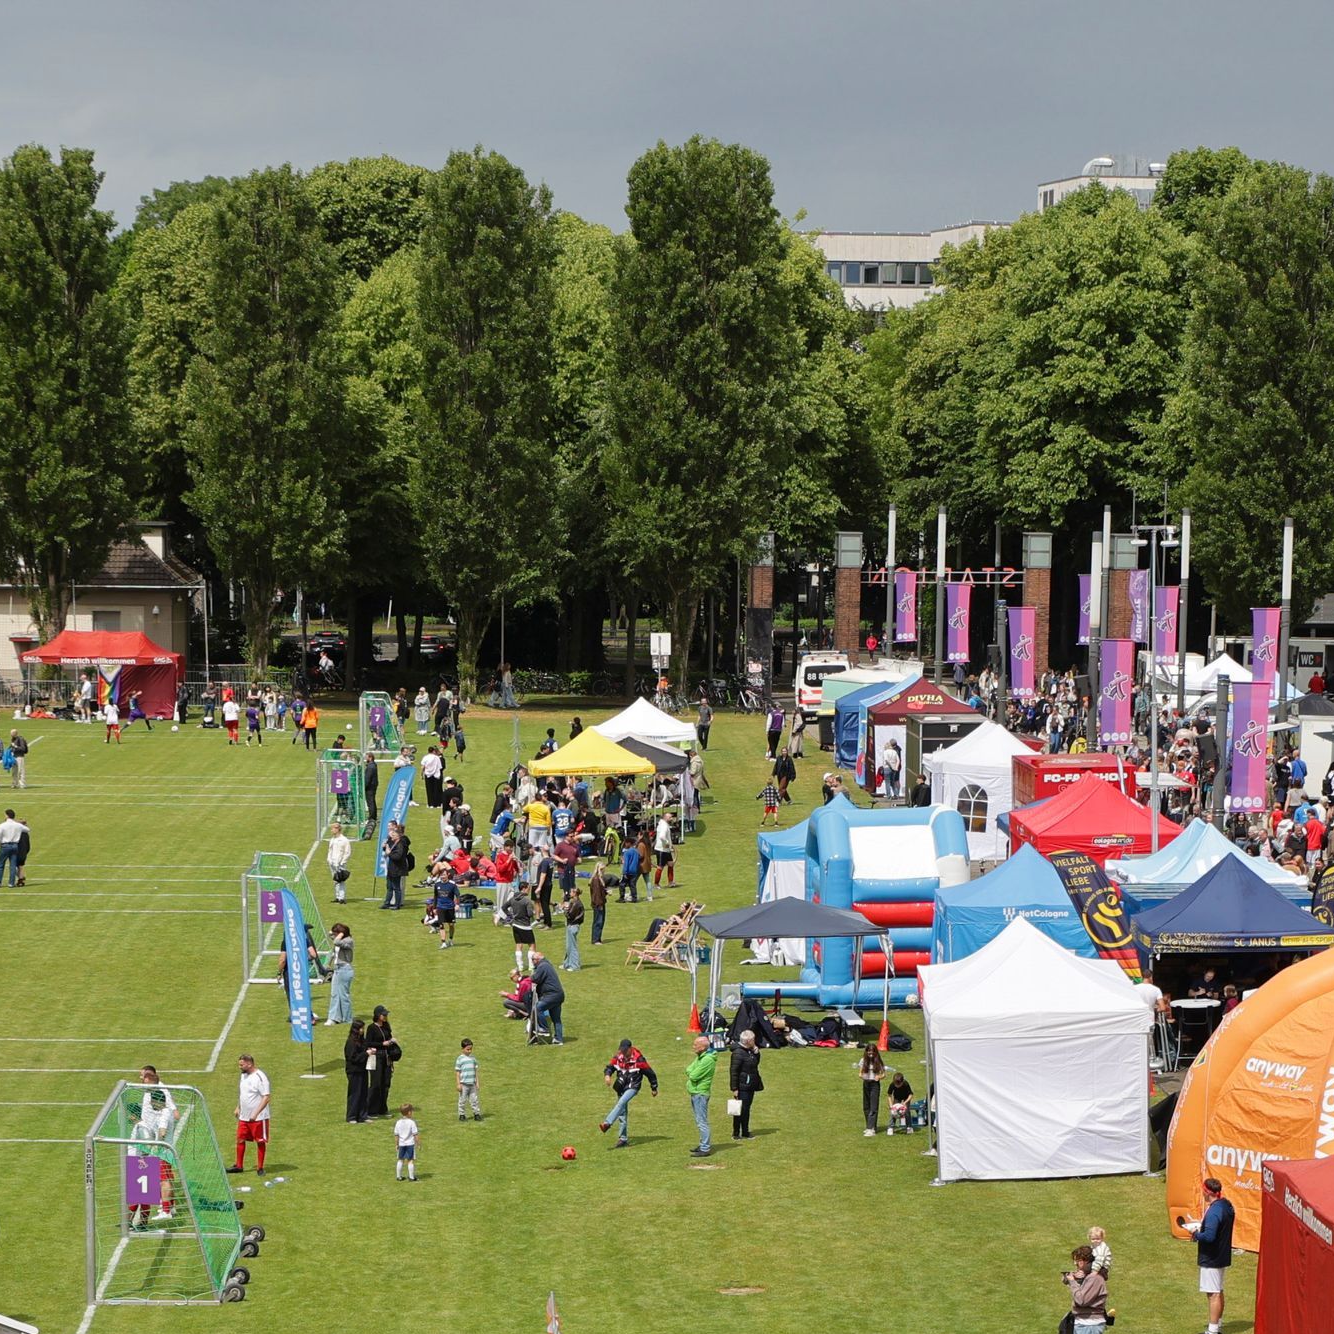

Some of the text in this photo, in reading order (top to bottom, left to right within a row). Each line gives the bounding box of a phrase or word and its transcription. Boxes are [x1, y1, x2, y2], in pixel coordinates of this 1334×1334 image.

[91, 657, 136, 665] willkommen
[1300, 654, 1314, 665] WC
[1043, 772, 1128, 783] FC-FAHOP
[335, 779, 343, 789] 5
[394, 779, 407, 826] ologne
[1053, 856, 1091, 868] VIELFALT
[1068, 865, 1097, 876] SPORT
[1065, 876, 1091, 887] LIEBE
[267, 903, 277, 916] 3
[1018, 908, 1070, 920] NetCologne
[1233, 937, 1277, 947] SC JANUS
[1245, 1056, 1308, 1082] anyway
[1206, 1144, 1291, 1177] anyw
[136, 1175, 149, 1194] 1
[1302, 1206, 1334, 1246] willkommen
